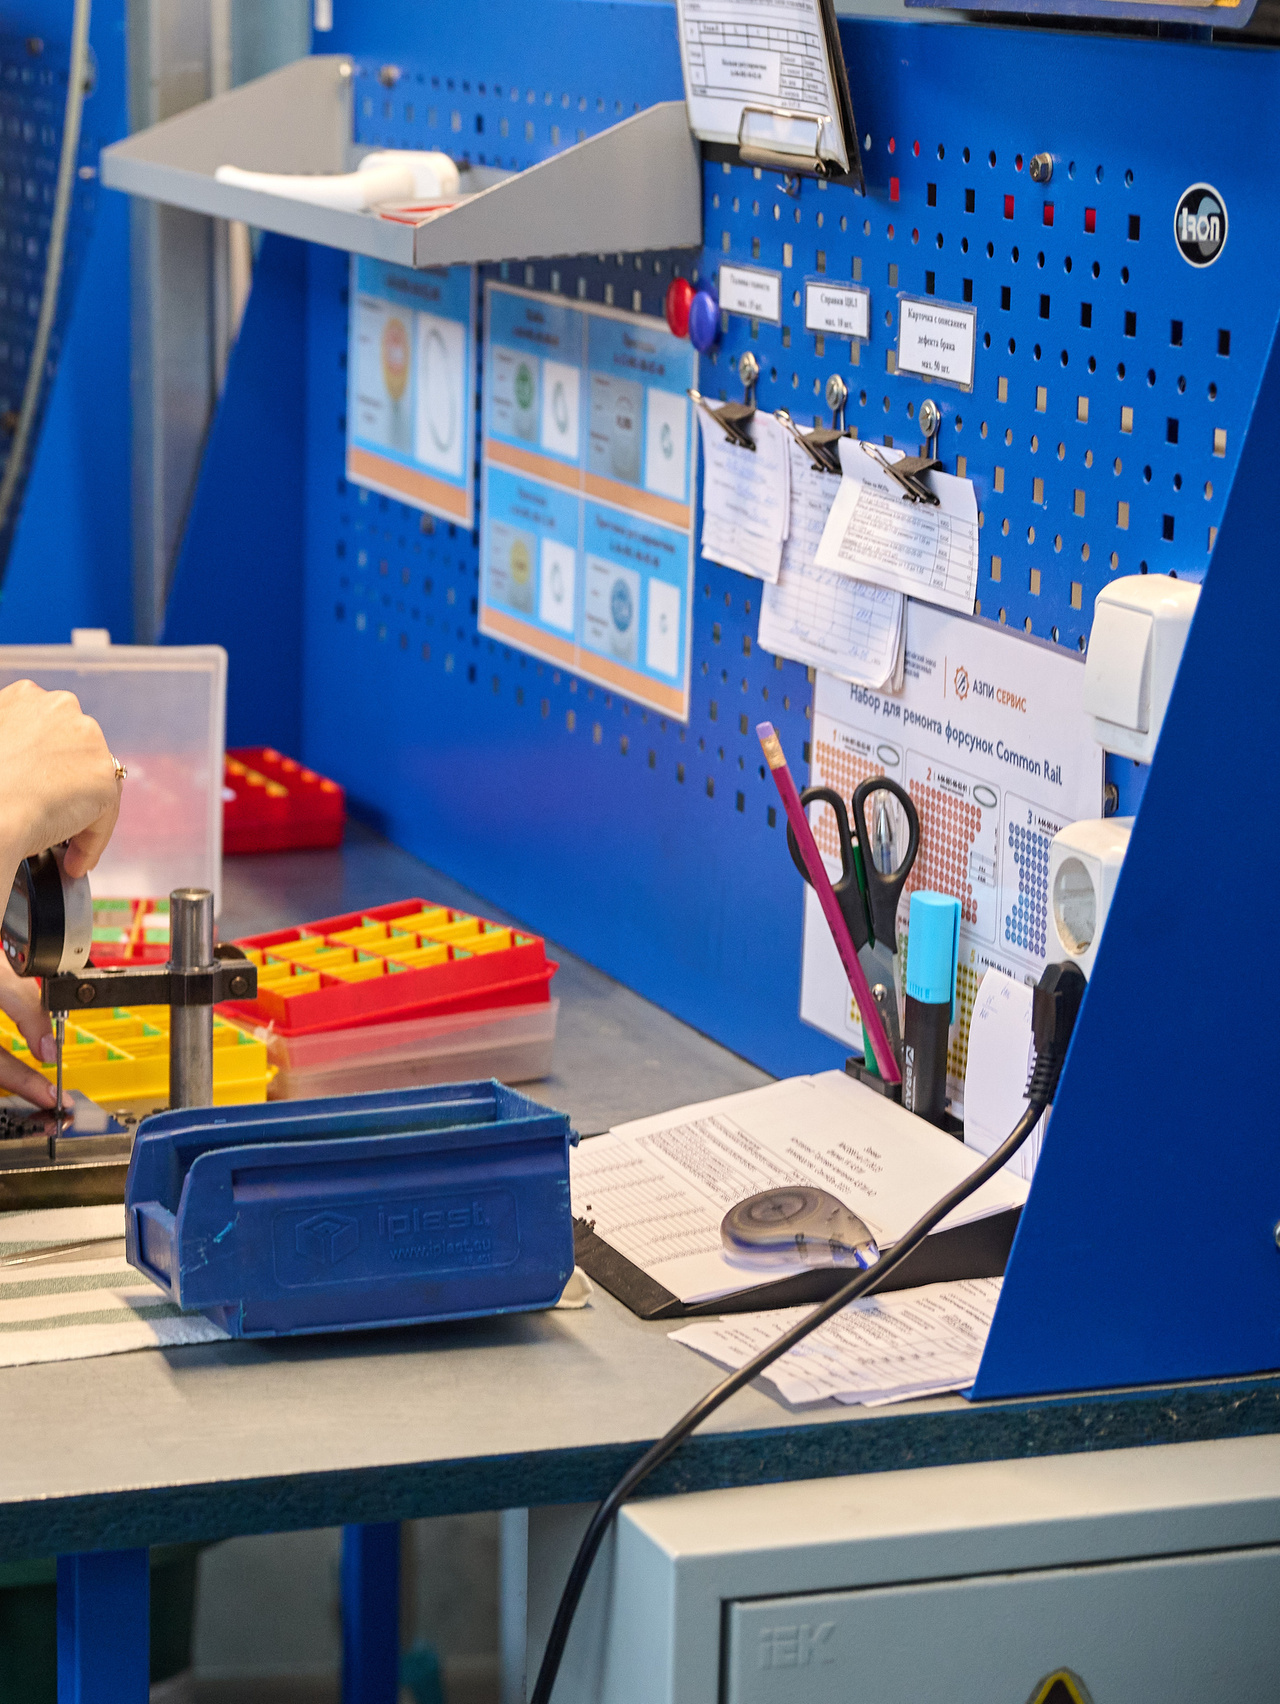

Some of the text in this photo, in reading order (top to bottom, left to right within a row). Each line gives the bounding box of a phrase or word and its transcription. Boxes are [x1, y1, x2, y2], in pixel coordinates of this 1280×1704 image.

[908, 307, 933, 323] Карточка
[938, 317, 967, 330] описанием
[917, 334, 956, 352] дефекта брака
[933, 360, 940, 371] 50
[972, 678, 1027, 713] АЗПИ СЕРВИС
[833, 729, 837, 742] 1
[850, 683, 1063, 786] Набор для ремонта форсунок Common Rail
[926, 767, 931, 781] 2
[1027, 809, 1033, 825] 3
[970, 949, 976, 964] 5
